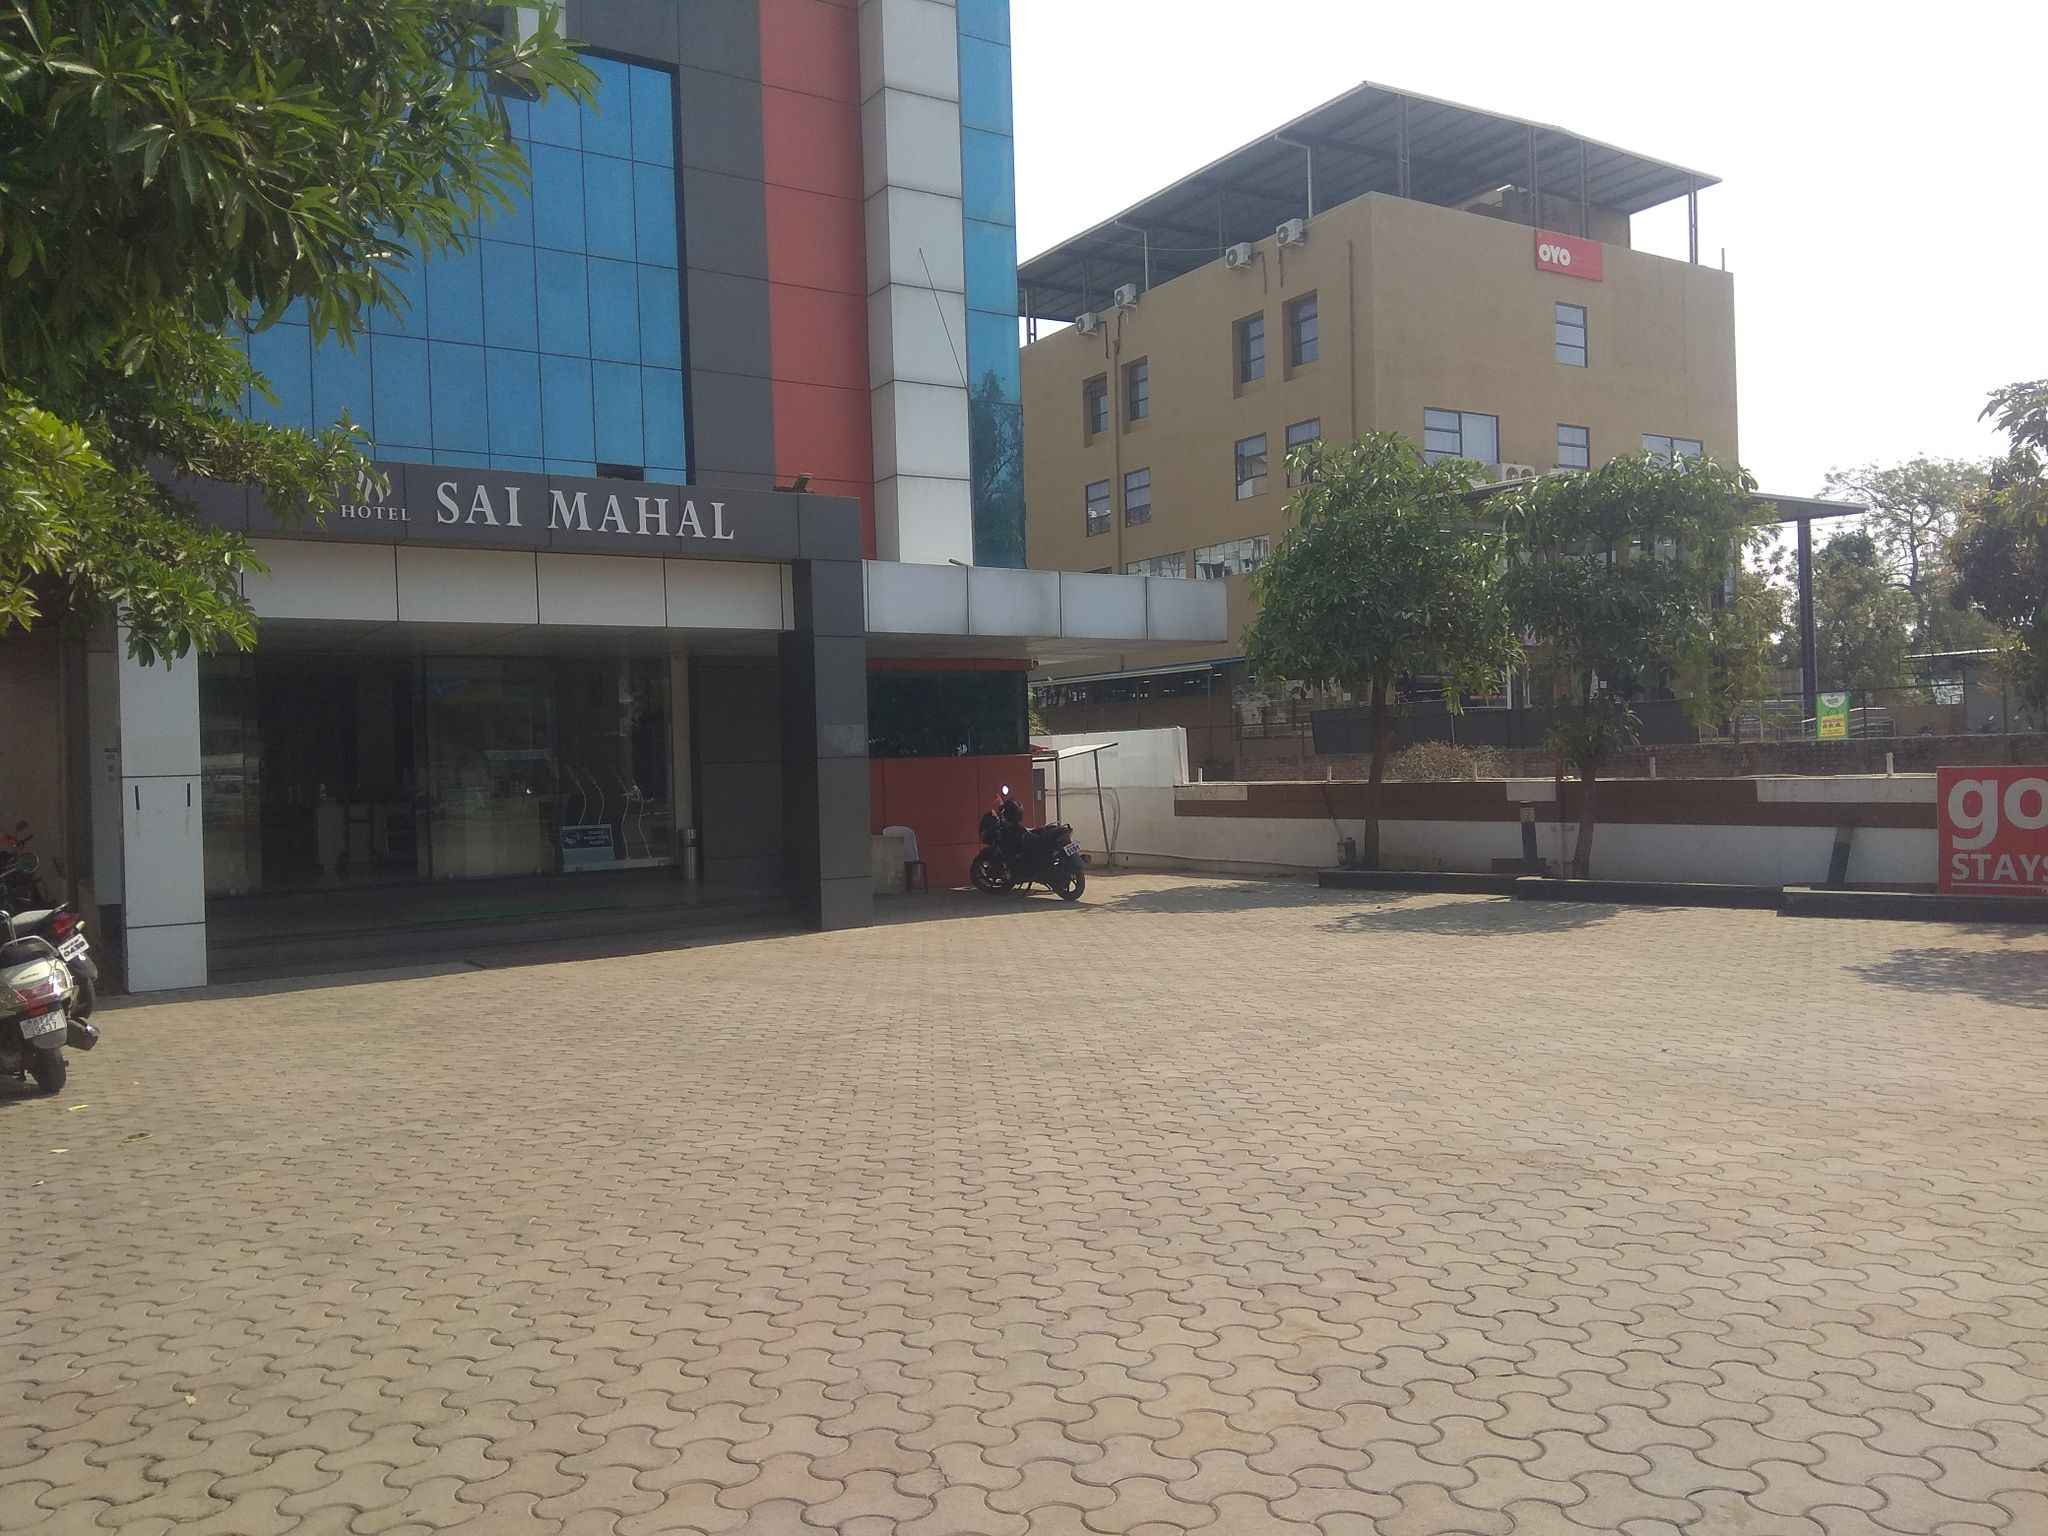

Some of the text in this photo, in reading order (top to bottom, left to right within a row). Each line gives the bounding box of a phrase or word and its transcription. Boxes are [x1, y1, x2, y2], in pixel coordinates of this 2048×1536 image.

[1538, 243, 1571, 266] OYO
[340, 481, 735, 540] HOTEL SAI MAHAL
[1948, 777, 2048, 850] go
